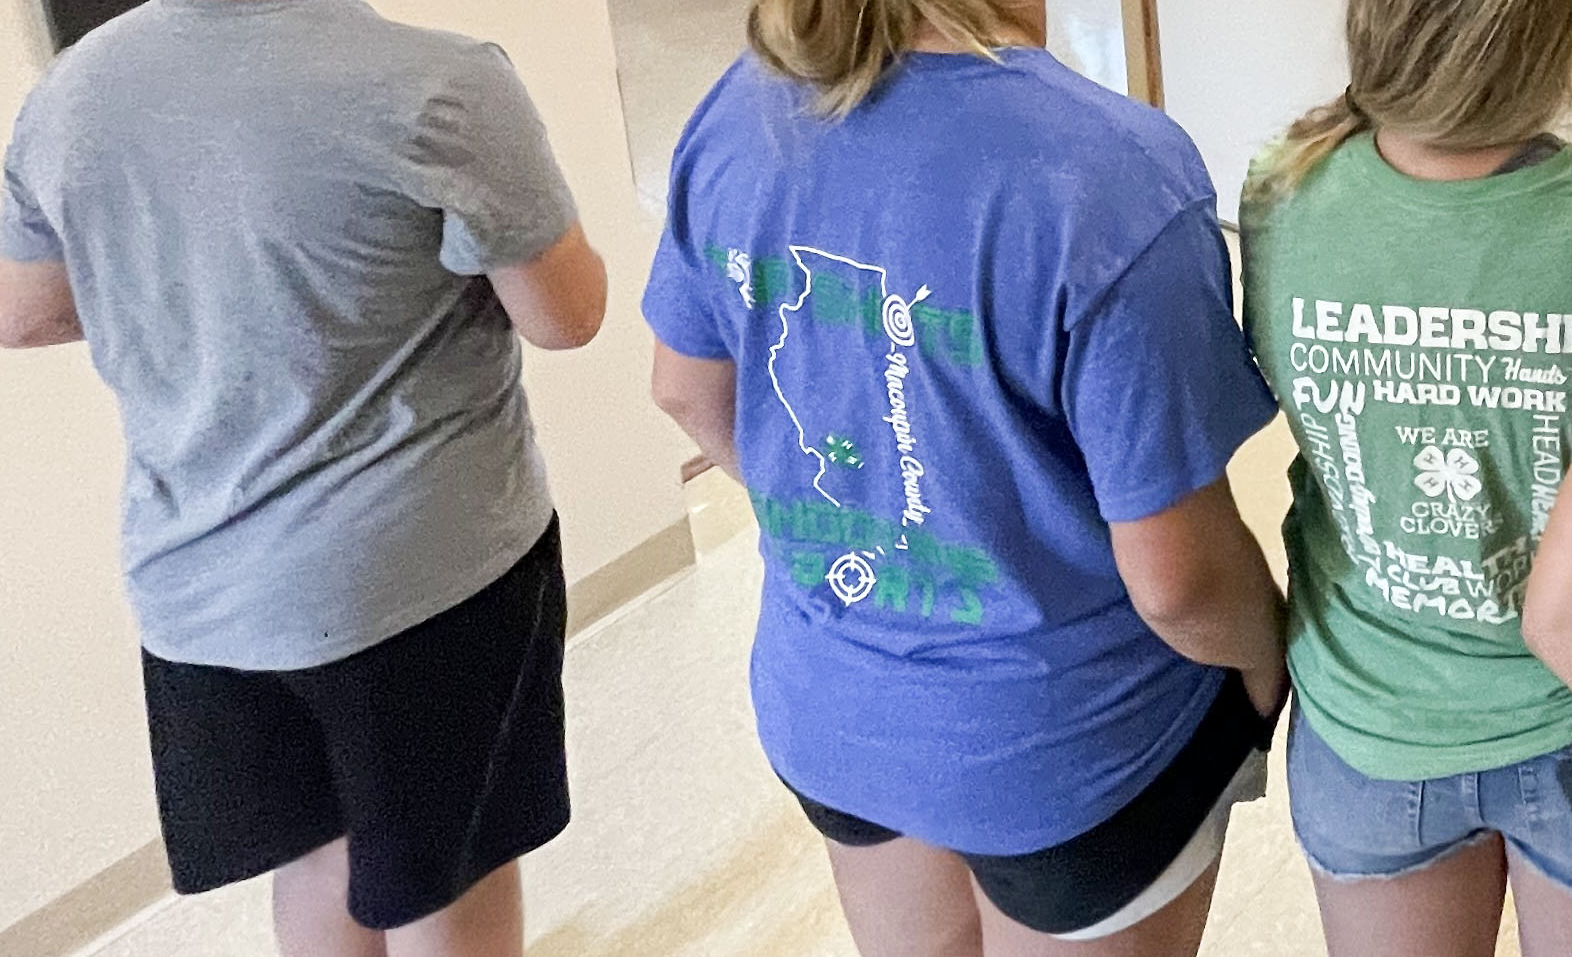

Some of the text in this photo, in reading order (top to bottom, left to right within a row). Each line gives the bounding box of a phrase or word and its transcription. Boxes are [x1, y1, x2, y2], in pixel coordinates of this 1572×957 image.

[1290, 341, 1497, 385] COMMUNITY
[1499, 354, 1570, 387] Hands
[1291, 376, 1366, 418] FUN
[1372, 378, 1567, 413] HARD WORK
[1395, 426, 1489, 449] WE ARE
[1531, 413, 1562, 485] HEAD
[1411, 502, 1493, 524] CRAZY
[1386, 564, 1460, 595] CLUB
